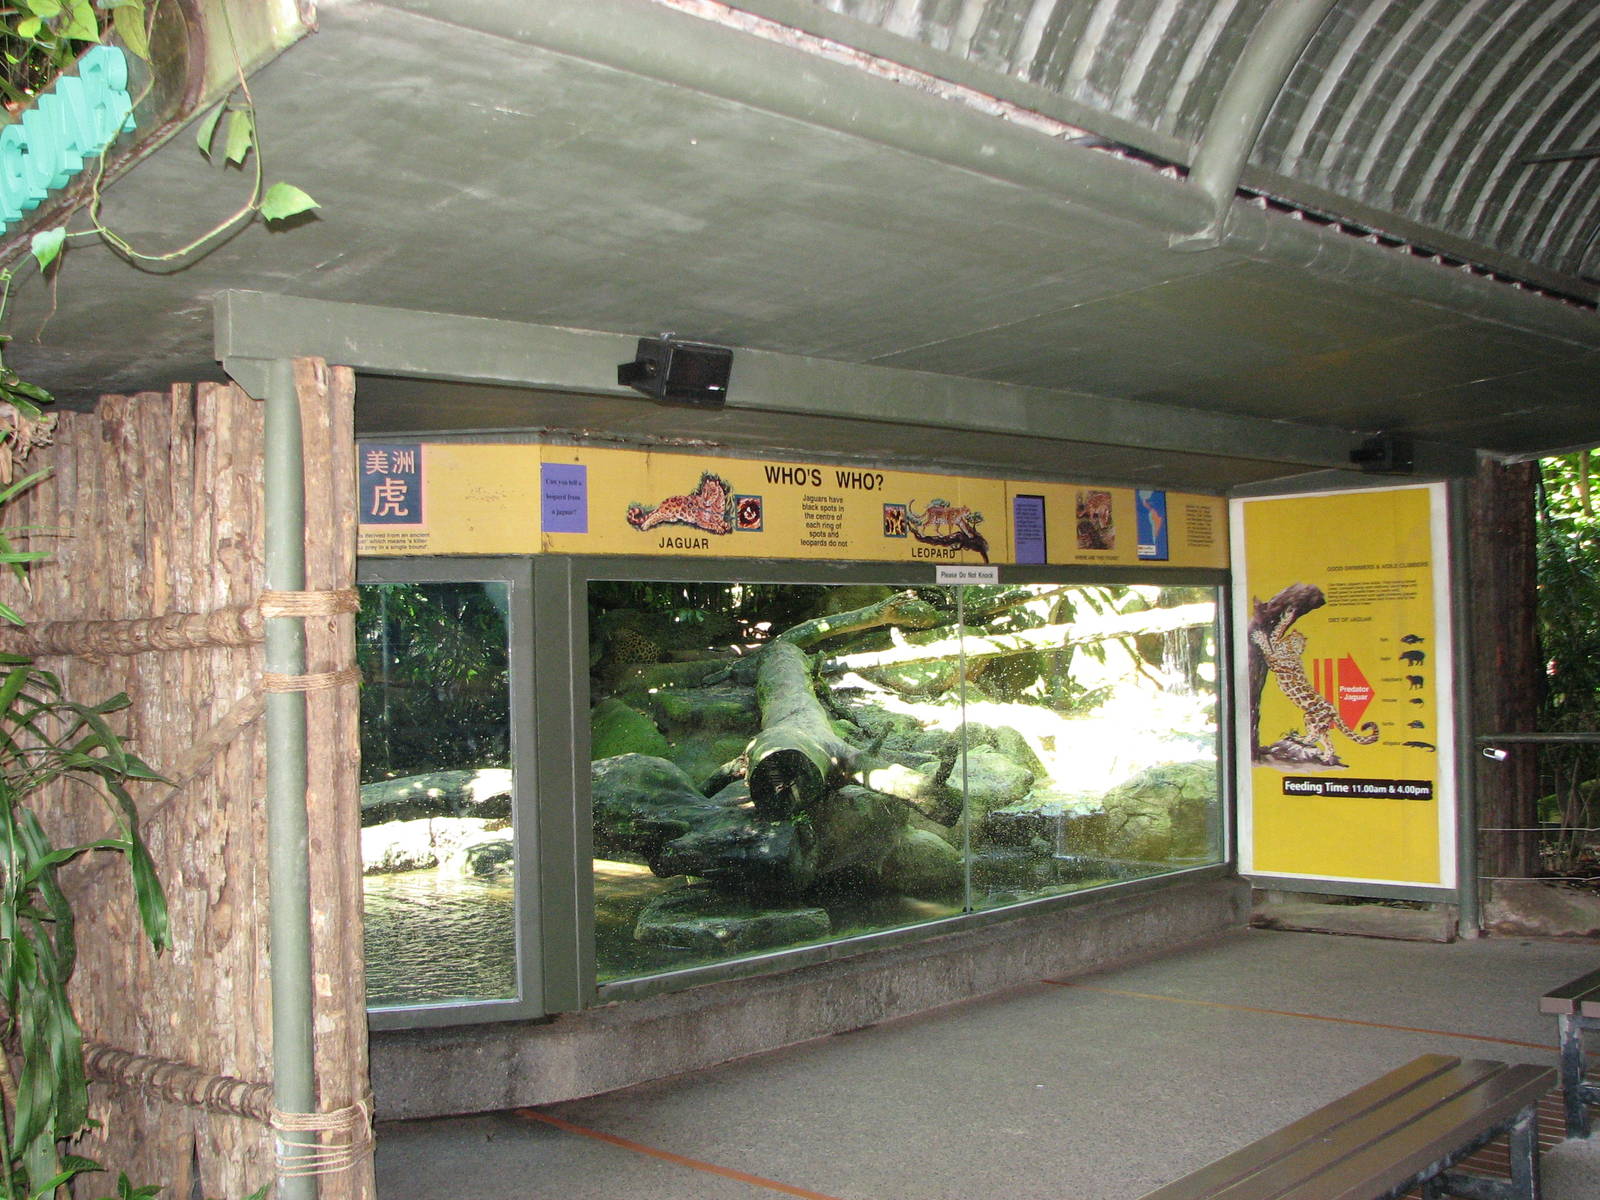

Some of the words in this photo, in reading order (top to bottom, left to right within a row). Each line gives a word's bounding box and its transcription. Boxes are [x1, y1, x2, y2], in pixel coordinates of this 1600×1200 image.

[366, 450, 415, 475] 美洲
[764, 465, 822, 487] WHO'S
[835, 470, 883, 491] WHO?
[370, 477, 409, 517] 虎
[803, 494, 828, 504] Jaguars
[802, 502, 819, 511] black
[820, 504, 837, 513] spots
[838, 505, 845, 513] in
[804, 512, 815, 520] the
[816, 513, 835, 521] centre
[806, 521, 821, 529] each
[822, 522, 834, 532] ring
[809, 530, 827, 539] spots
[827, 530, 840, 538] and
[659, 537, 709, 549] JAGUAR
[800, 538, 827, 548] leopards
[837, 540, 848, 548] not
[912, 547, 956, 559] LEOPARD
[1344, 693, 1368, 702] Jaguar
[1284, 780, 1322, 794] Feeding
[1324, 782, 1349, 793] Time
[1352, 784, 1387, 794] 11.00am
[1388, 785, 1396, 794] &
[1397, 785, 1430, 796] 4.00pm
